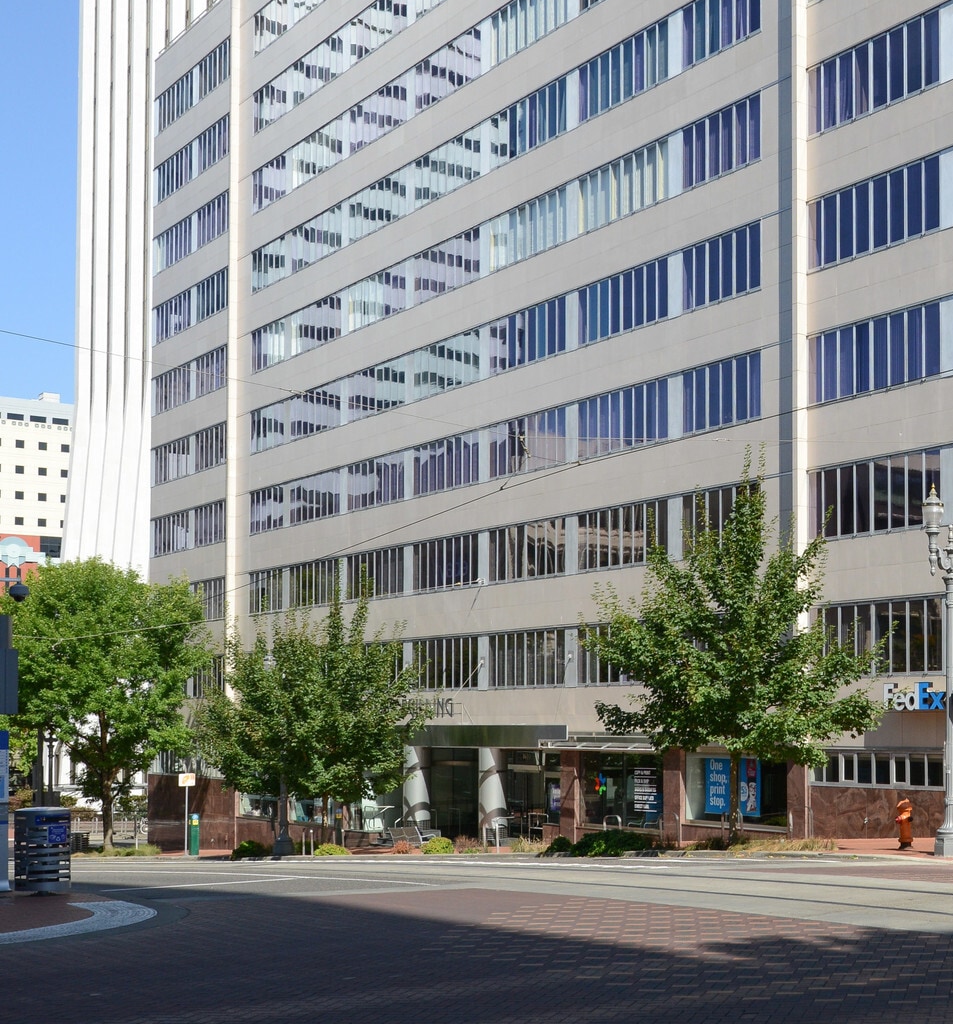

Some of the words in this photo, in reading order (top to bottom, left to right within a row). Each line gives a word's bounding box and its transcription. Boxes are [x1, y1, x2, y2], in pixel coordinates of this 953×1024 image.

[883, 682, 945, 711] FedEx
[710, 759, 723, 770] One
[710, 771, 727, 785] shop,
[710, 783, 725, 797] print
[710, 796, 726, 809] stop.
